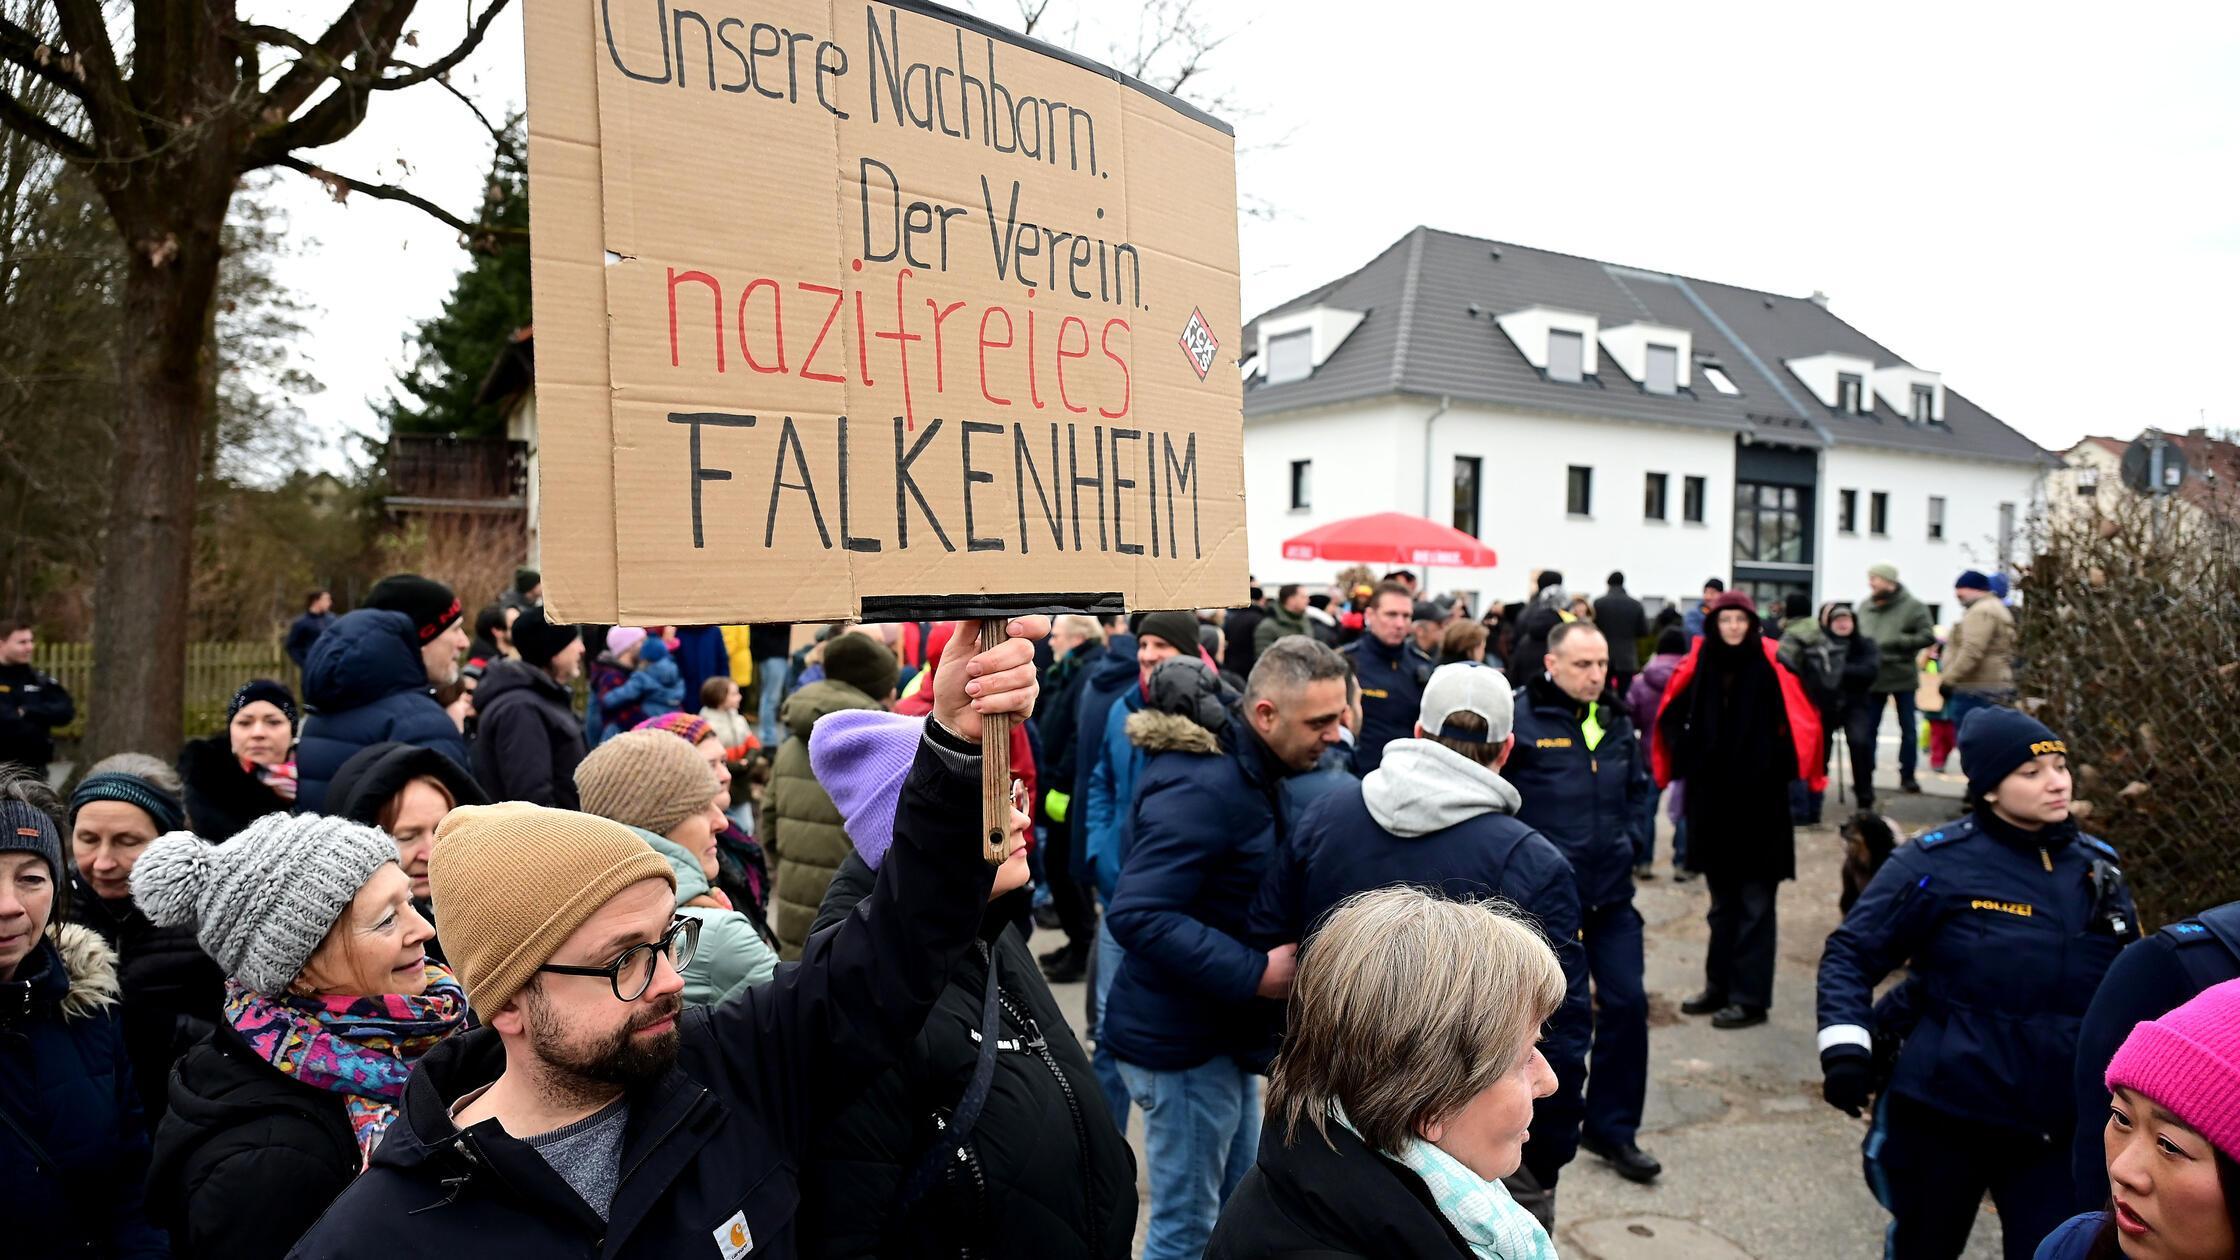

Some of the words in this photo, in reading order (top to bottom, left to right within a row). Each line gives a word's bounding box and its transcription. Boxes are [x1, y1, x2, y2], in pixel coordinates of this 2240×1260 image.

[601, 0, 850, 120] Unsere
[866, 4, 1108, 180] Nachbarn.
[860, 157, 968, 272] Der
[980, 174, 1149, 312] Verein.
[666, 258, 1131, 431] nazifreies
[1183, 326, 1210, 372] NZS
[1188, 314, 1216, 362] FCK
[667, 411, 1200, 559] FALKENHEIM
[1971, 899, 2033, 917] POLIZEI
